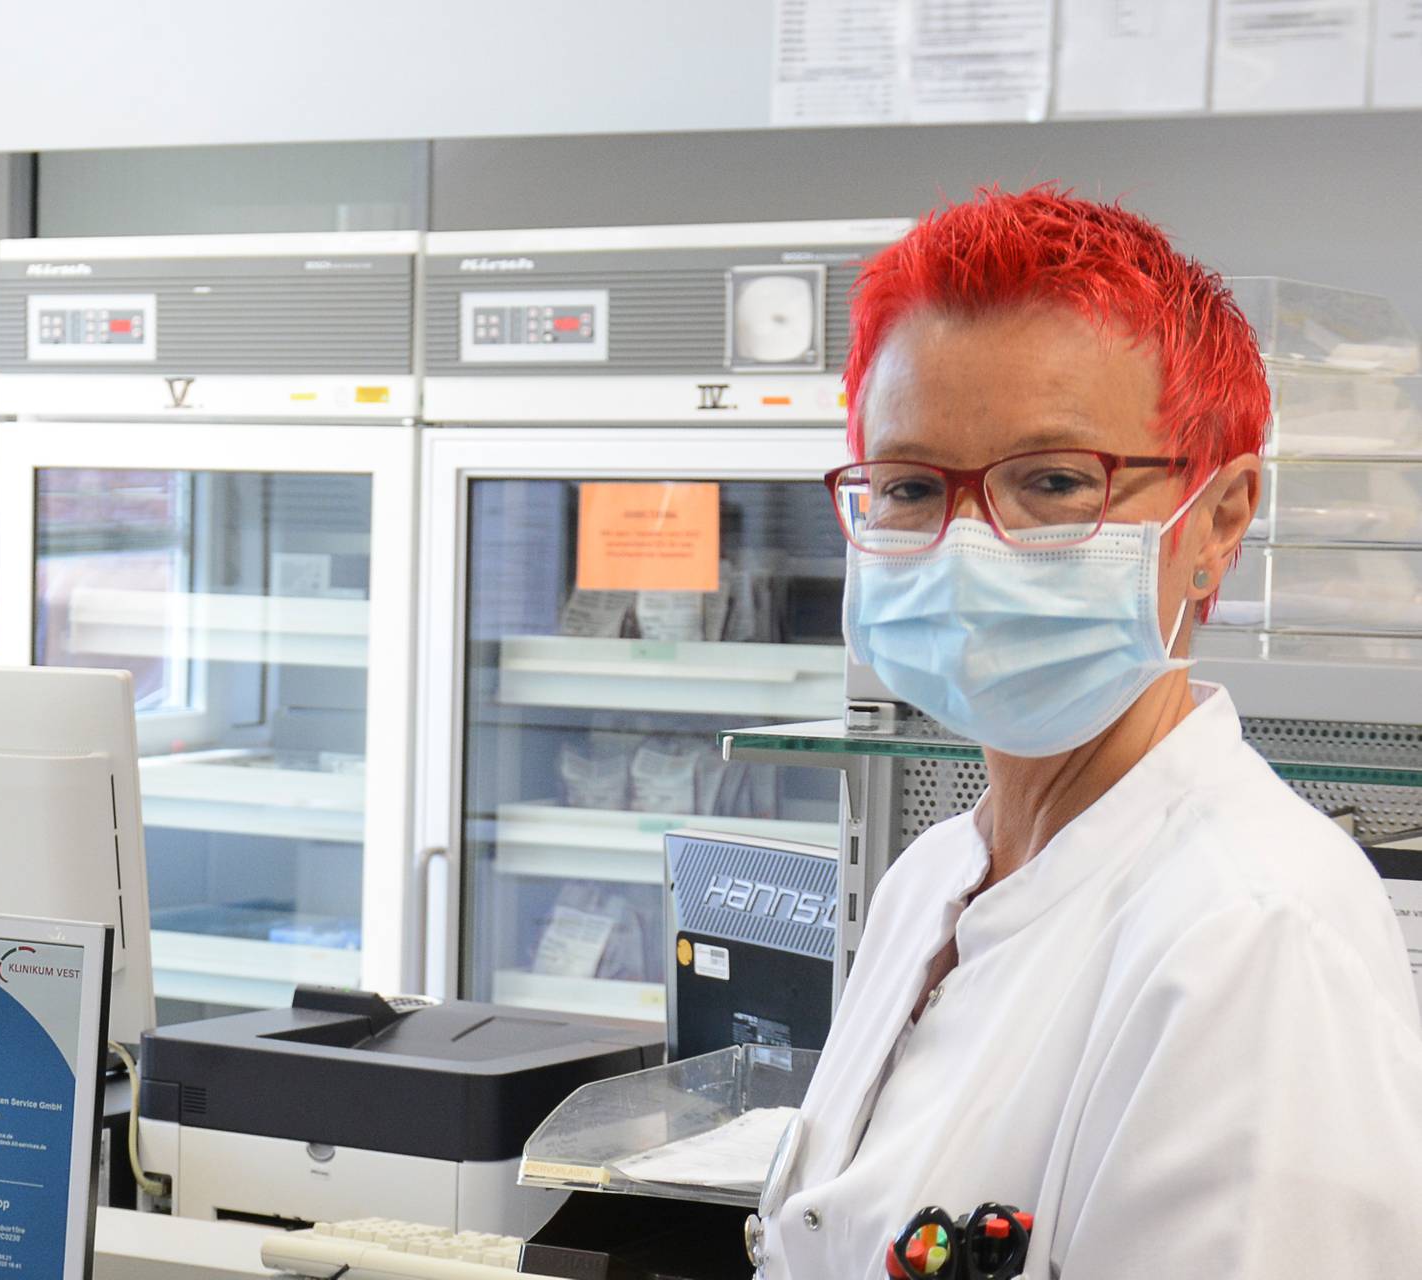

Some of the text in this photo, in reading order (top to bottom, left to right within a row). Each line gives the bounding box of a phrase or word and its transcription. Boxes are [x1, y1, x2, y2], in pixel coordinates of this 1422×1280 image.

[8, 963, 81, 978] KLINIKUM VEST
[11, 1098, 37, 1108] Service
[39, 1101, 63, 1110] GmbH
